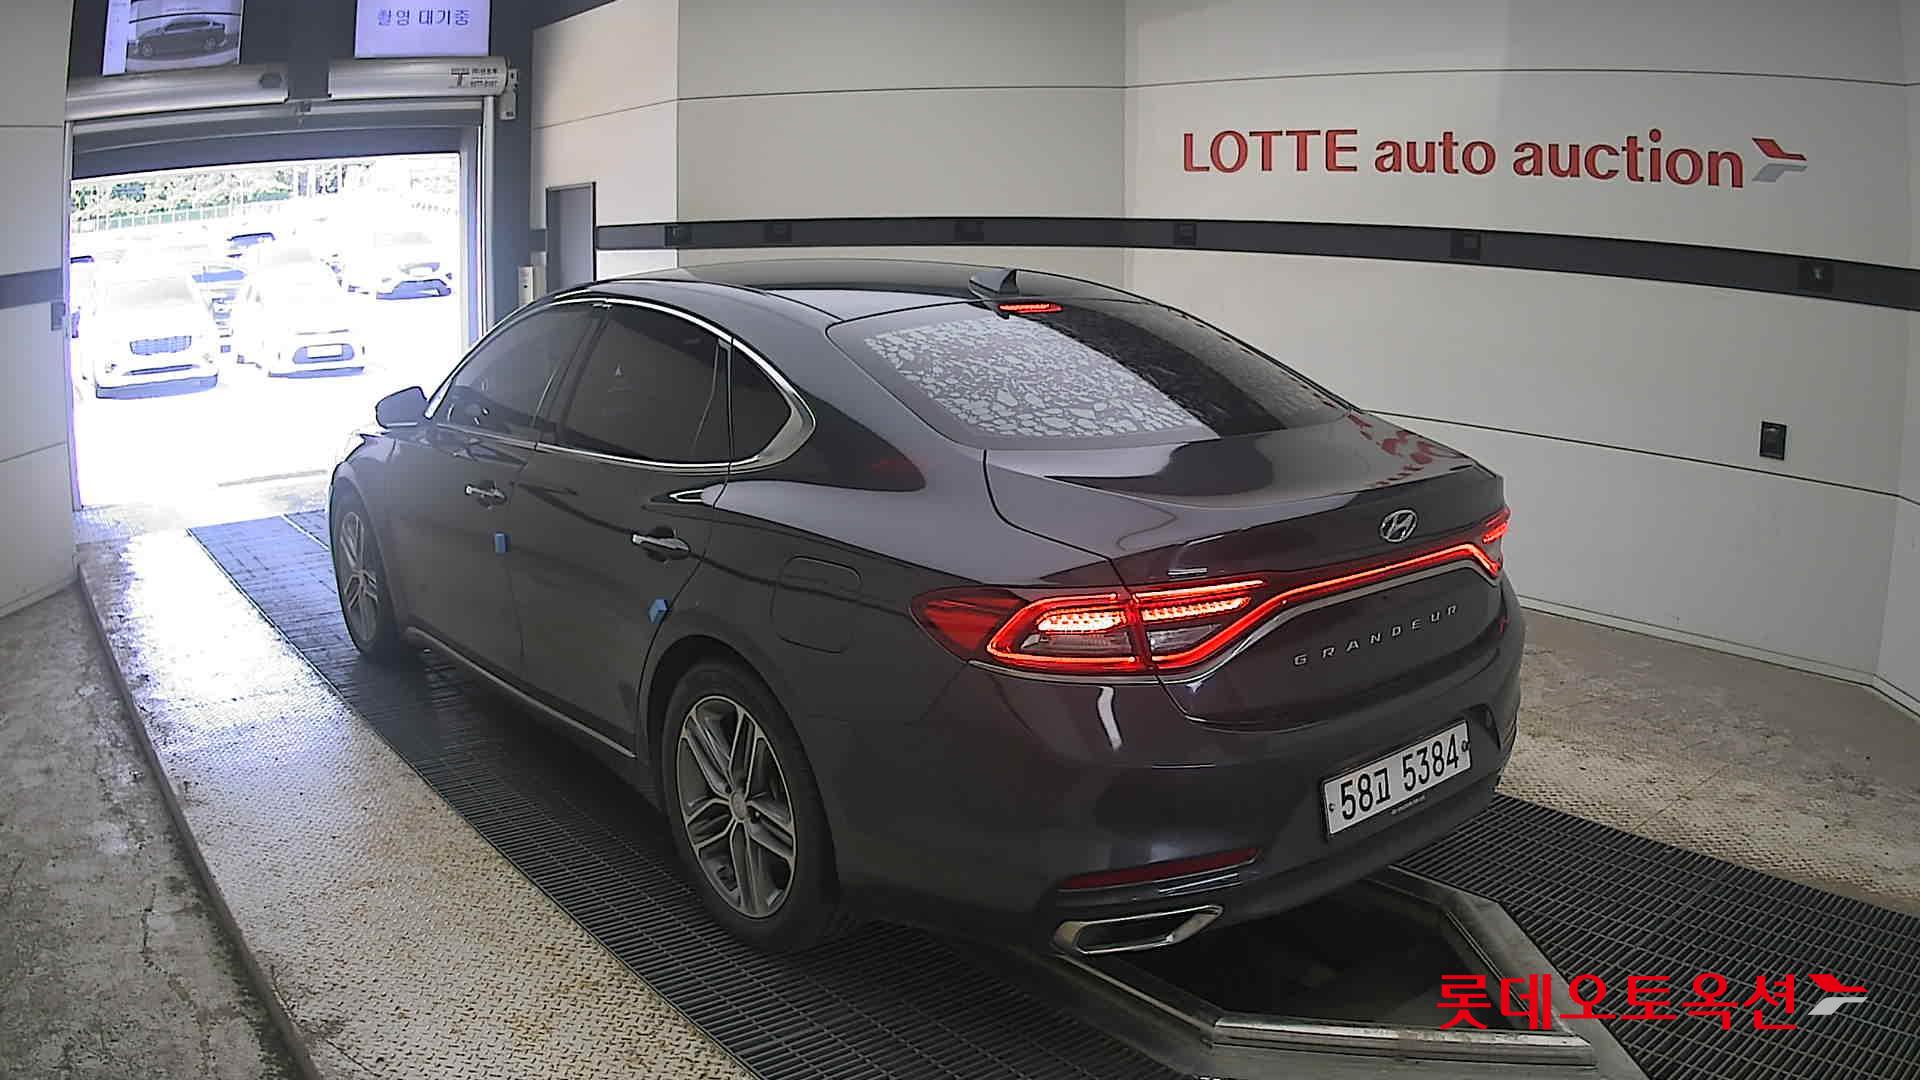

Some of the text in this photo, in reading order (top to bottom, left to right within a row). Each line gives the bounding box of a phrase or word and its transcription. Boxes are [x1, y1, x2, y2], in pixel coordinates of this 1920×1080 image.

[418, 9, 470, 26] 대기중
[1183, 128, 1744, 188] LOTTE auto auction
[1293, 604, 1457, 666] GRANDEUR
[1340, 733, 1459, 820] 58고 5384
